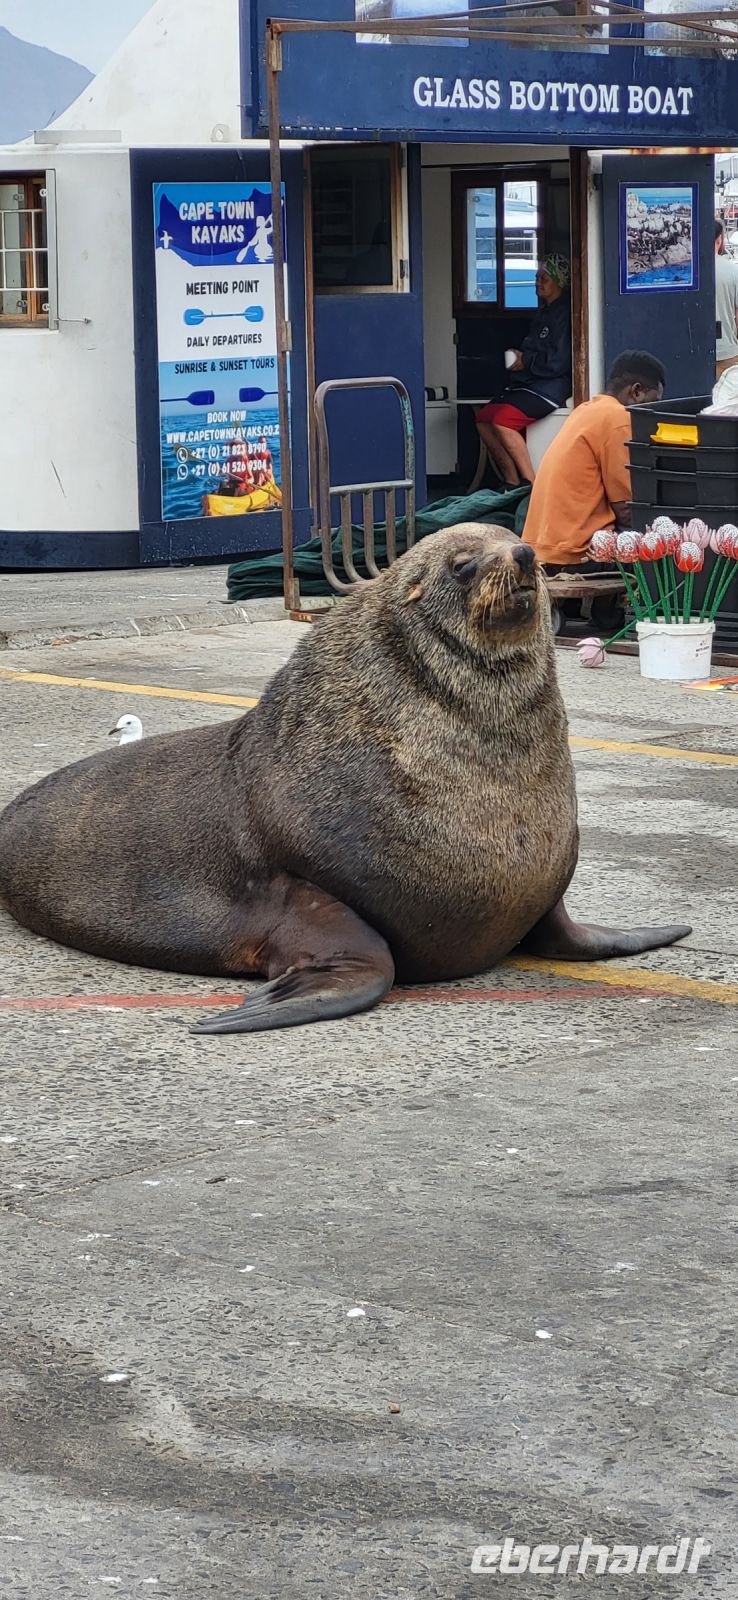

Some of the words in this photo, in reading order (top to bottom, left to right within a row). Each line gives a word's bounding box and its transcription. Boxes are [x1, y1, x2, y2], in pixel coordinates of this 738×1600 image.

[413, 75, 501, 110] GLASS
[509, 80, 620, 113] BOTTOM
[627, 85, 694, 115] BOAT
[179, 202, 215, 221] CAPE
[218, 201, 255, 220] TOWN
[191, 224, 245, 244] KAYAKS
[186, 281, 229, 295] MEETING
[232, 280, 260, 293] POINT
[187, 335, 210, 347] DAILY
[212, 333, 262, 346] DEPARTURES
[174, 362, 208, 374] SUNRISE
[210, 361, 216, 372] &
[219, 359, 248, 371] SUNSET
[251, 358, 275, 369] TOURS
[207, 411, 228, 424] BOOK
[230, 410, 247, 422] NOW
[166, 424, 280, 444] WWW.CAPETOWNKAYAKS.CO.Z
[190, 447, 206, 459] +27
[208, 444, 220, 460] (0)
[222, 445, 230, 457] 21
[190, 464, 206, 476] +27
[208, 461, 220, 477] (0)
[222, 462, 230, 474] 61
[231, 461, 246, 473] 526
